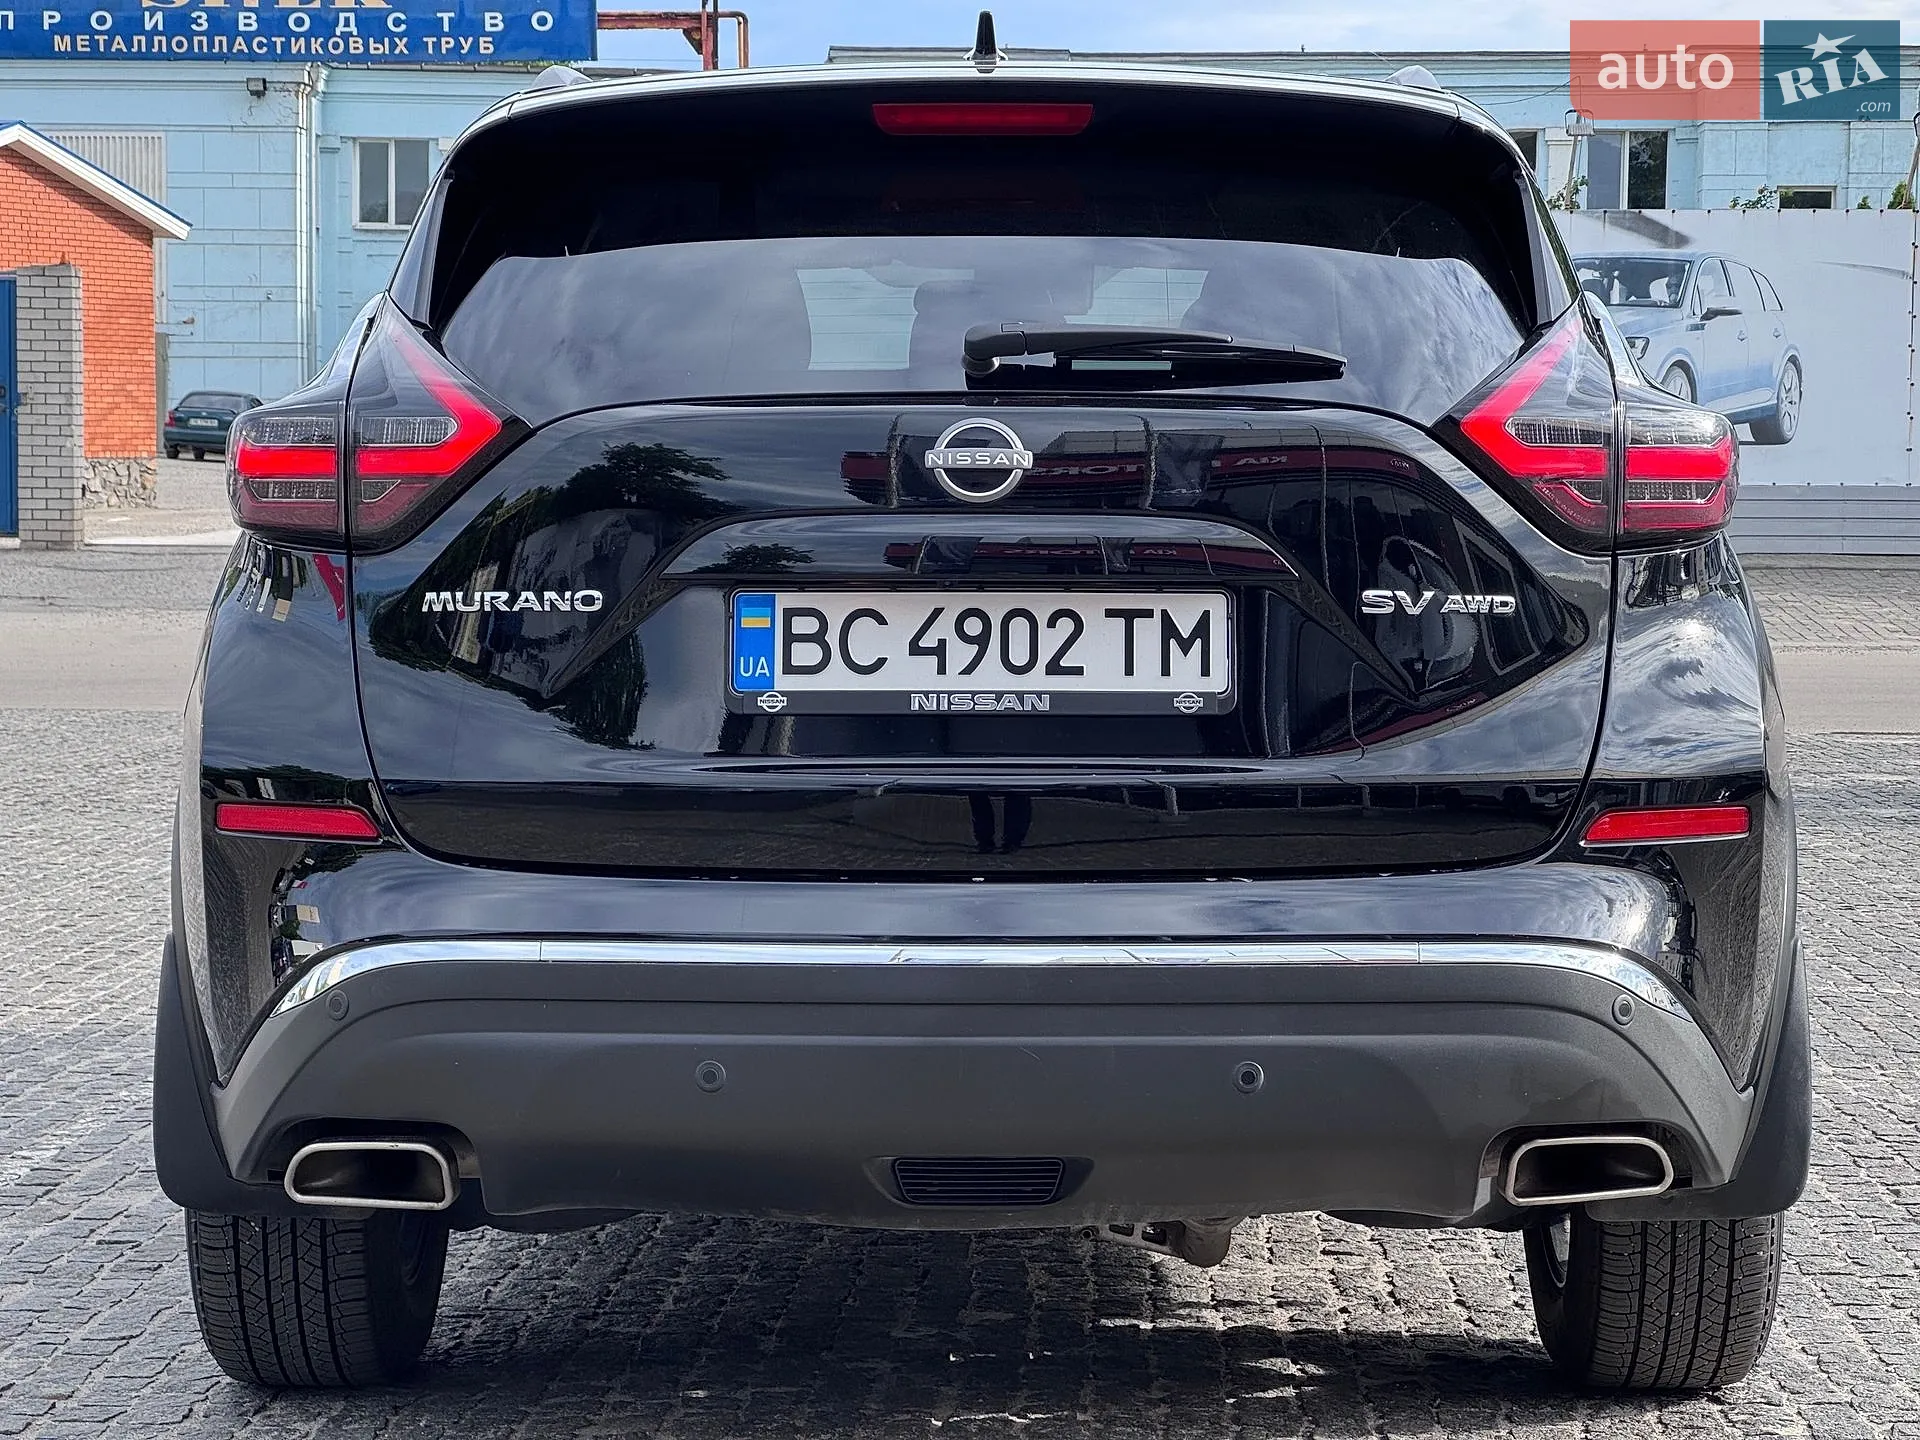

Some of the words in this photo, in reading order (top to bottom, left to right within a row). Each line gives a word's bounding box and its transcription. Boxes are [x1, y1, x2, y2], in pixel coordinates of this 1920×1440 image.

[0, 10, 554, 35] ПРОИЗВОДСТВО
[53, 34, 409, 55] МЕТАЛЛОПЛАСТИКОВЫХ
[422, 36, 495, 55] ТРУБ
[928, 452, 1029, 466] NISSAN
[421, 590, 604, 612] MURANO
[1361, 590, 1435, 615] SV
[1440, 595, 1516, 614] AWD
[781, 607, 889, 676] BC
[908, 607, 1085, 676] 4902
[1104, 608, 1211, 677] TM
[740, 656, 770, 677] UA
[910, 693, 1050, 711] NISSAN
